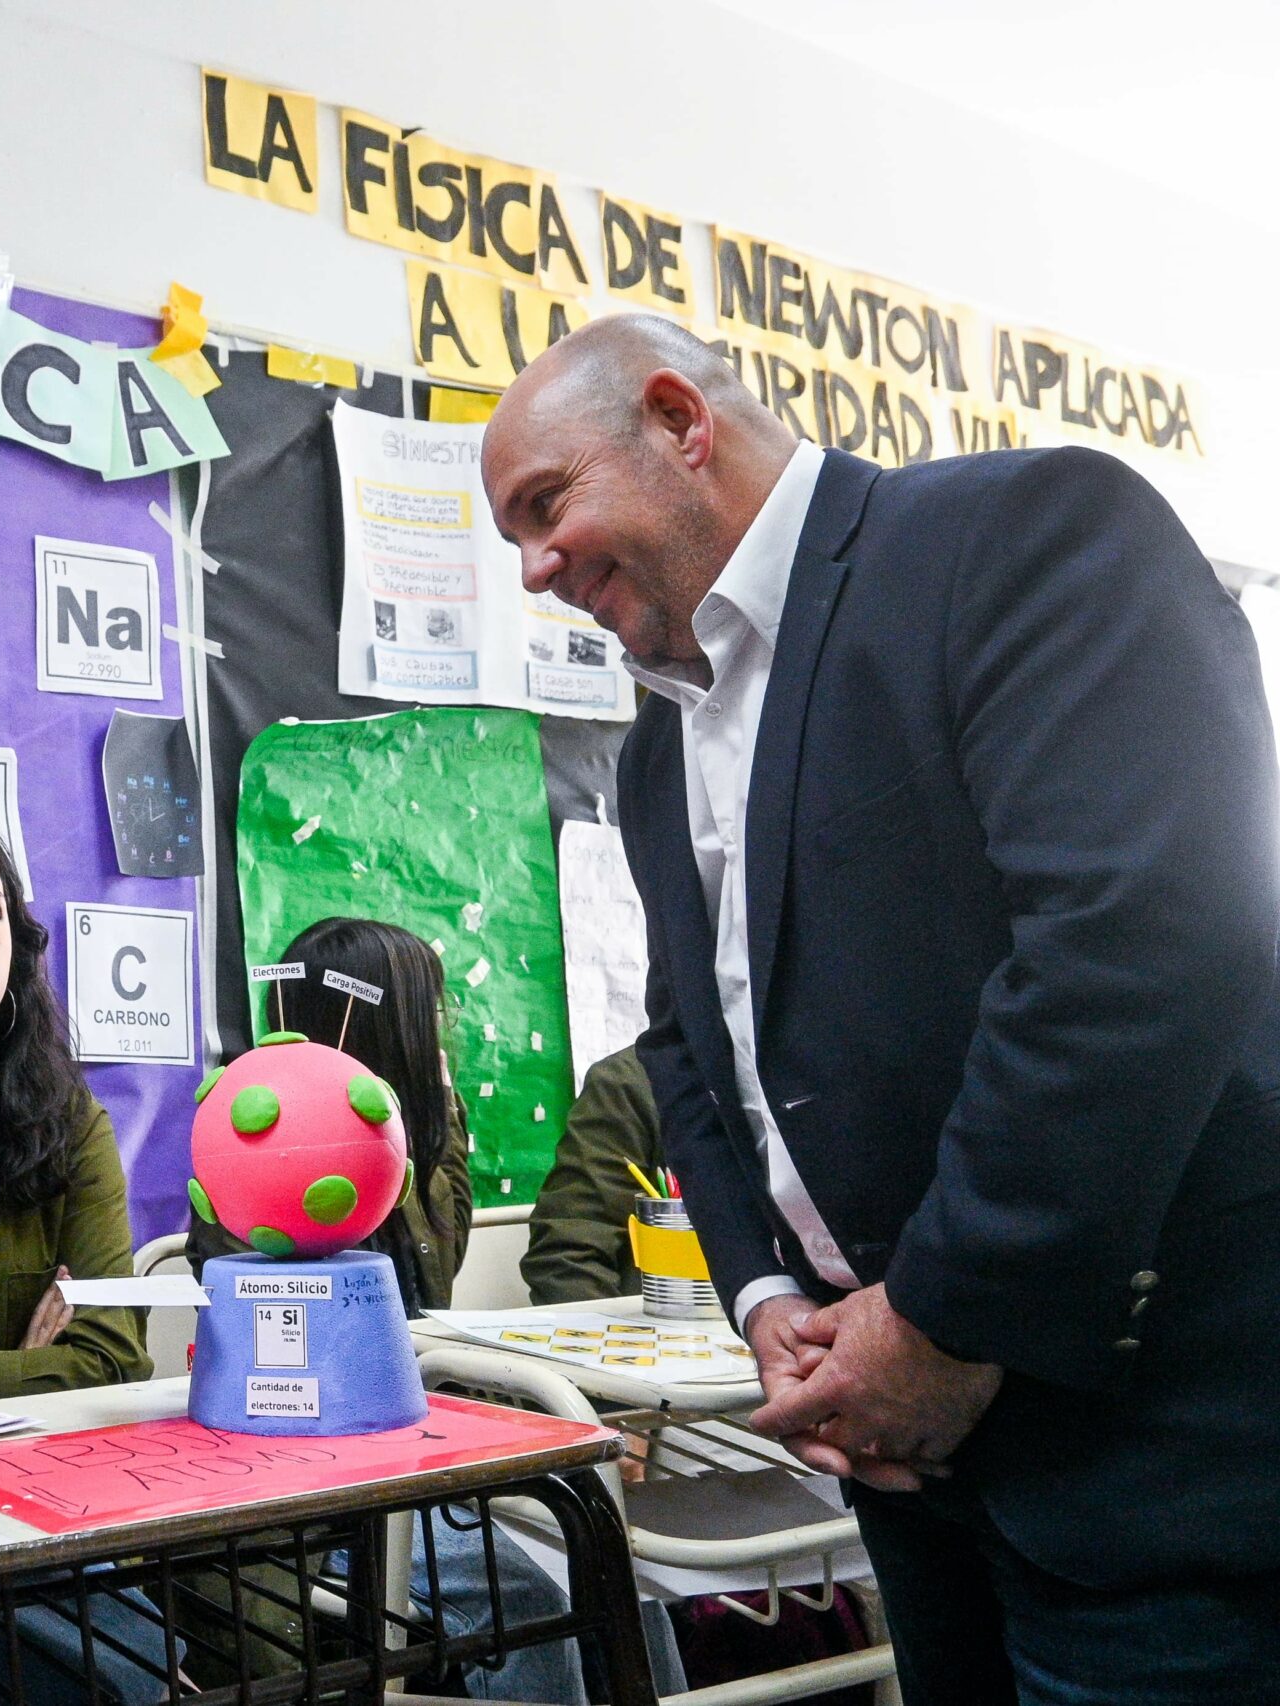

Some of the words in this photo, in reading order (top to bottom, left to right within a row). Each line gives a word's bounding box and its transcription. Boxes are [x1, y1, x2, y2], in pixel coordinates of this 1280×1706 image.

[204, 75, 313, 194] LA
[345, 126, 589, 286] FÍSICA
[602, 197, 686, 304] DE
[718, 237, 969, 393] NEWTON
[995, 329, 1206, 457] APLICADA
[419, 272, 481, 369] A
[52, 559, 67, 576] 11
[56, 585, 143, 652] Na
[77, 661, 122, 679] 22.990
[79, 915, 92, 936] 6
[111, 945, 147, 1001] C
[253, 965, 301, 977] Electrones
[326, 973, 350, 989] Carga
[351, 982, 380, 1001] Positiva
[93, 1009, 171, 1028] CARBONO
[117, 1039, 152, 1053] 12.011
[240, 1280, 284, 1294] Átomo:
[287, 1282, 328, 1294] Silicio
[258, 1311, 272, 1321] 14
[282, 1309, 298, 1325] Si
[281, 1329, 301, 1337] Silicio
[251, 1382, 290, 1392] Cantidad
[291, 1383, 303, 1393] de
[251, 1401, 301, 1412] electrones:
[303, 1402, 314, 1412] 14
